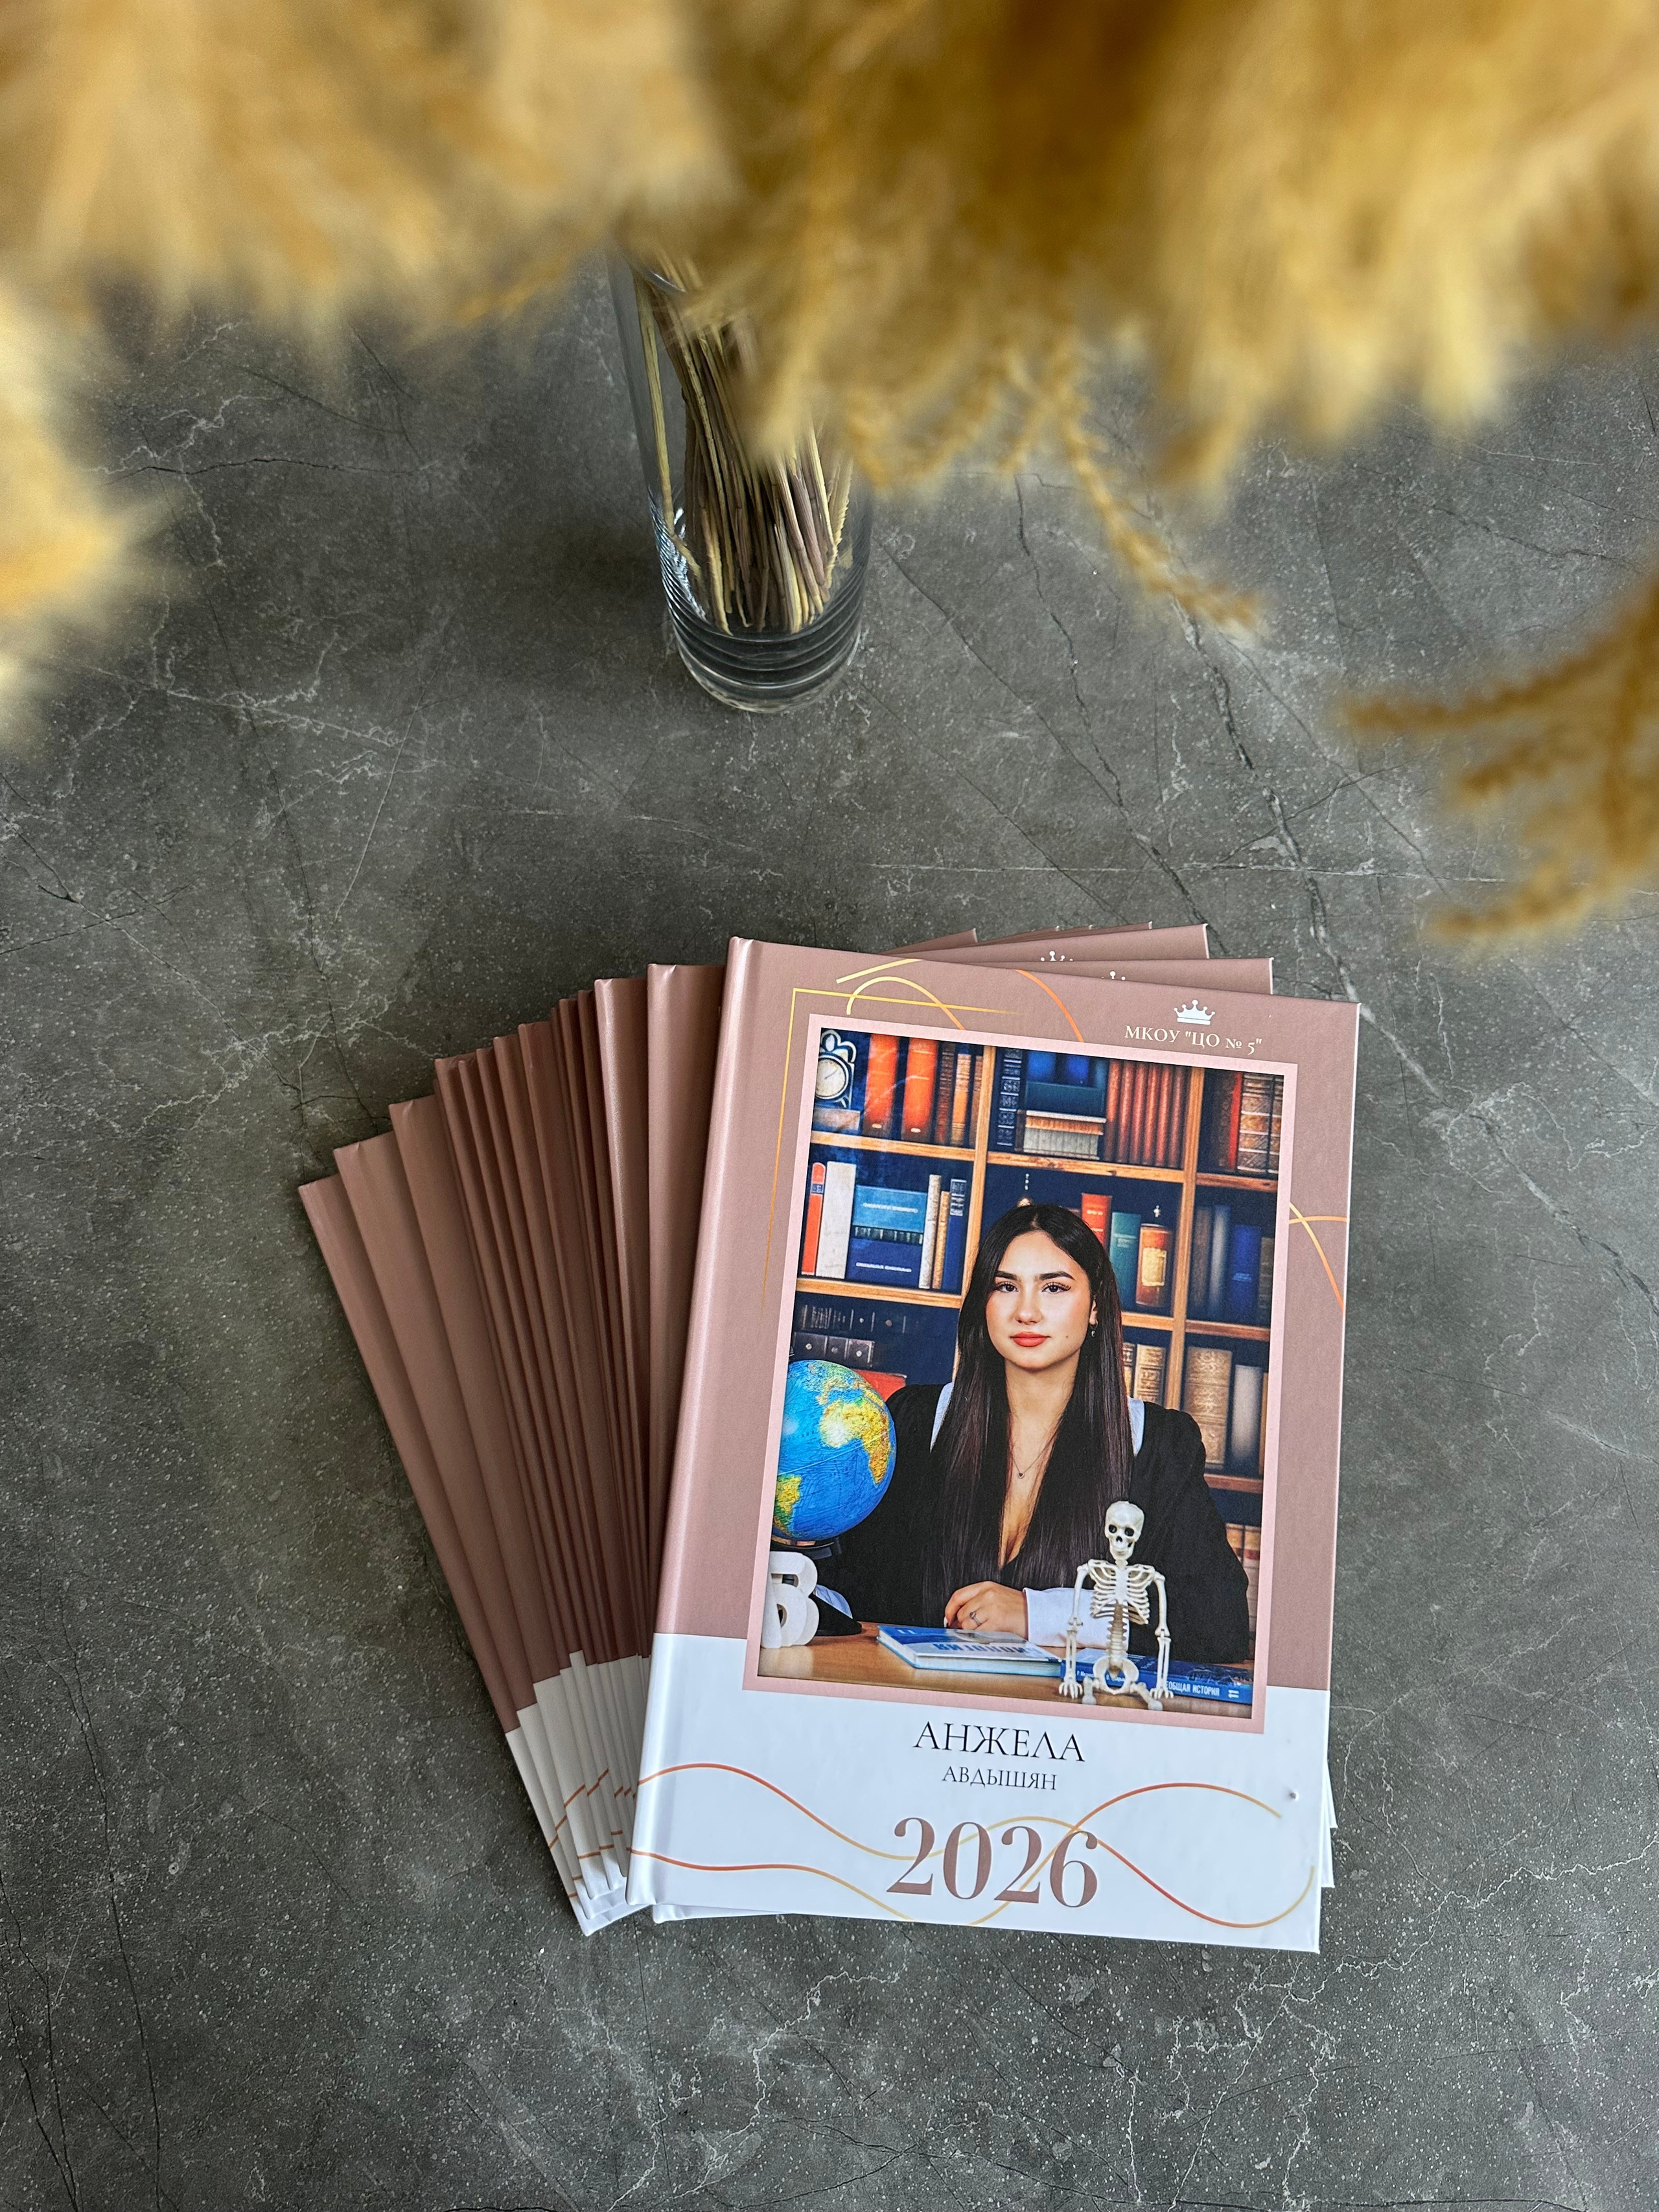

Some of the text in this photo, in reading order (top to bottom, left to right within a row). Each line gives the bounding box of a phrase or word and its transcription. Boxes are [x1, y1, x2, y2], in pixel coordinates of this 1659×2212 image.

[1124, 1025, 1262, 1055] МКОУ "ЦО № 5"
[1192, 1684, 1220, 1697] ИСТОРИЯ
[912, 1721, 1085, 1762] АНЖЕЛА
[941, 1765, 1058, 1790] АВДЫШЯН
[886, 1817, 1098, 1908] 2026
